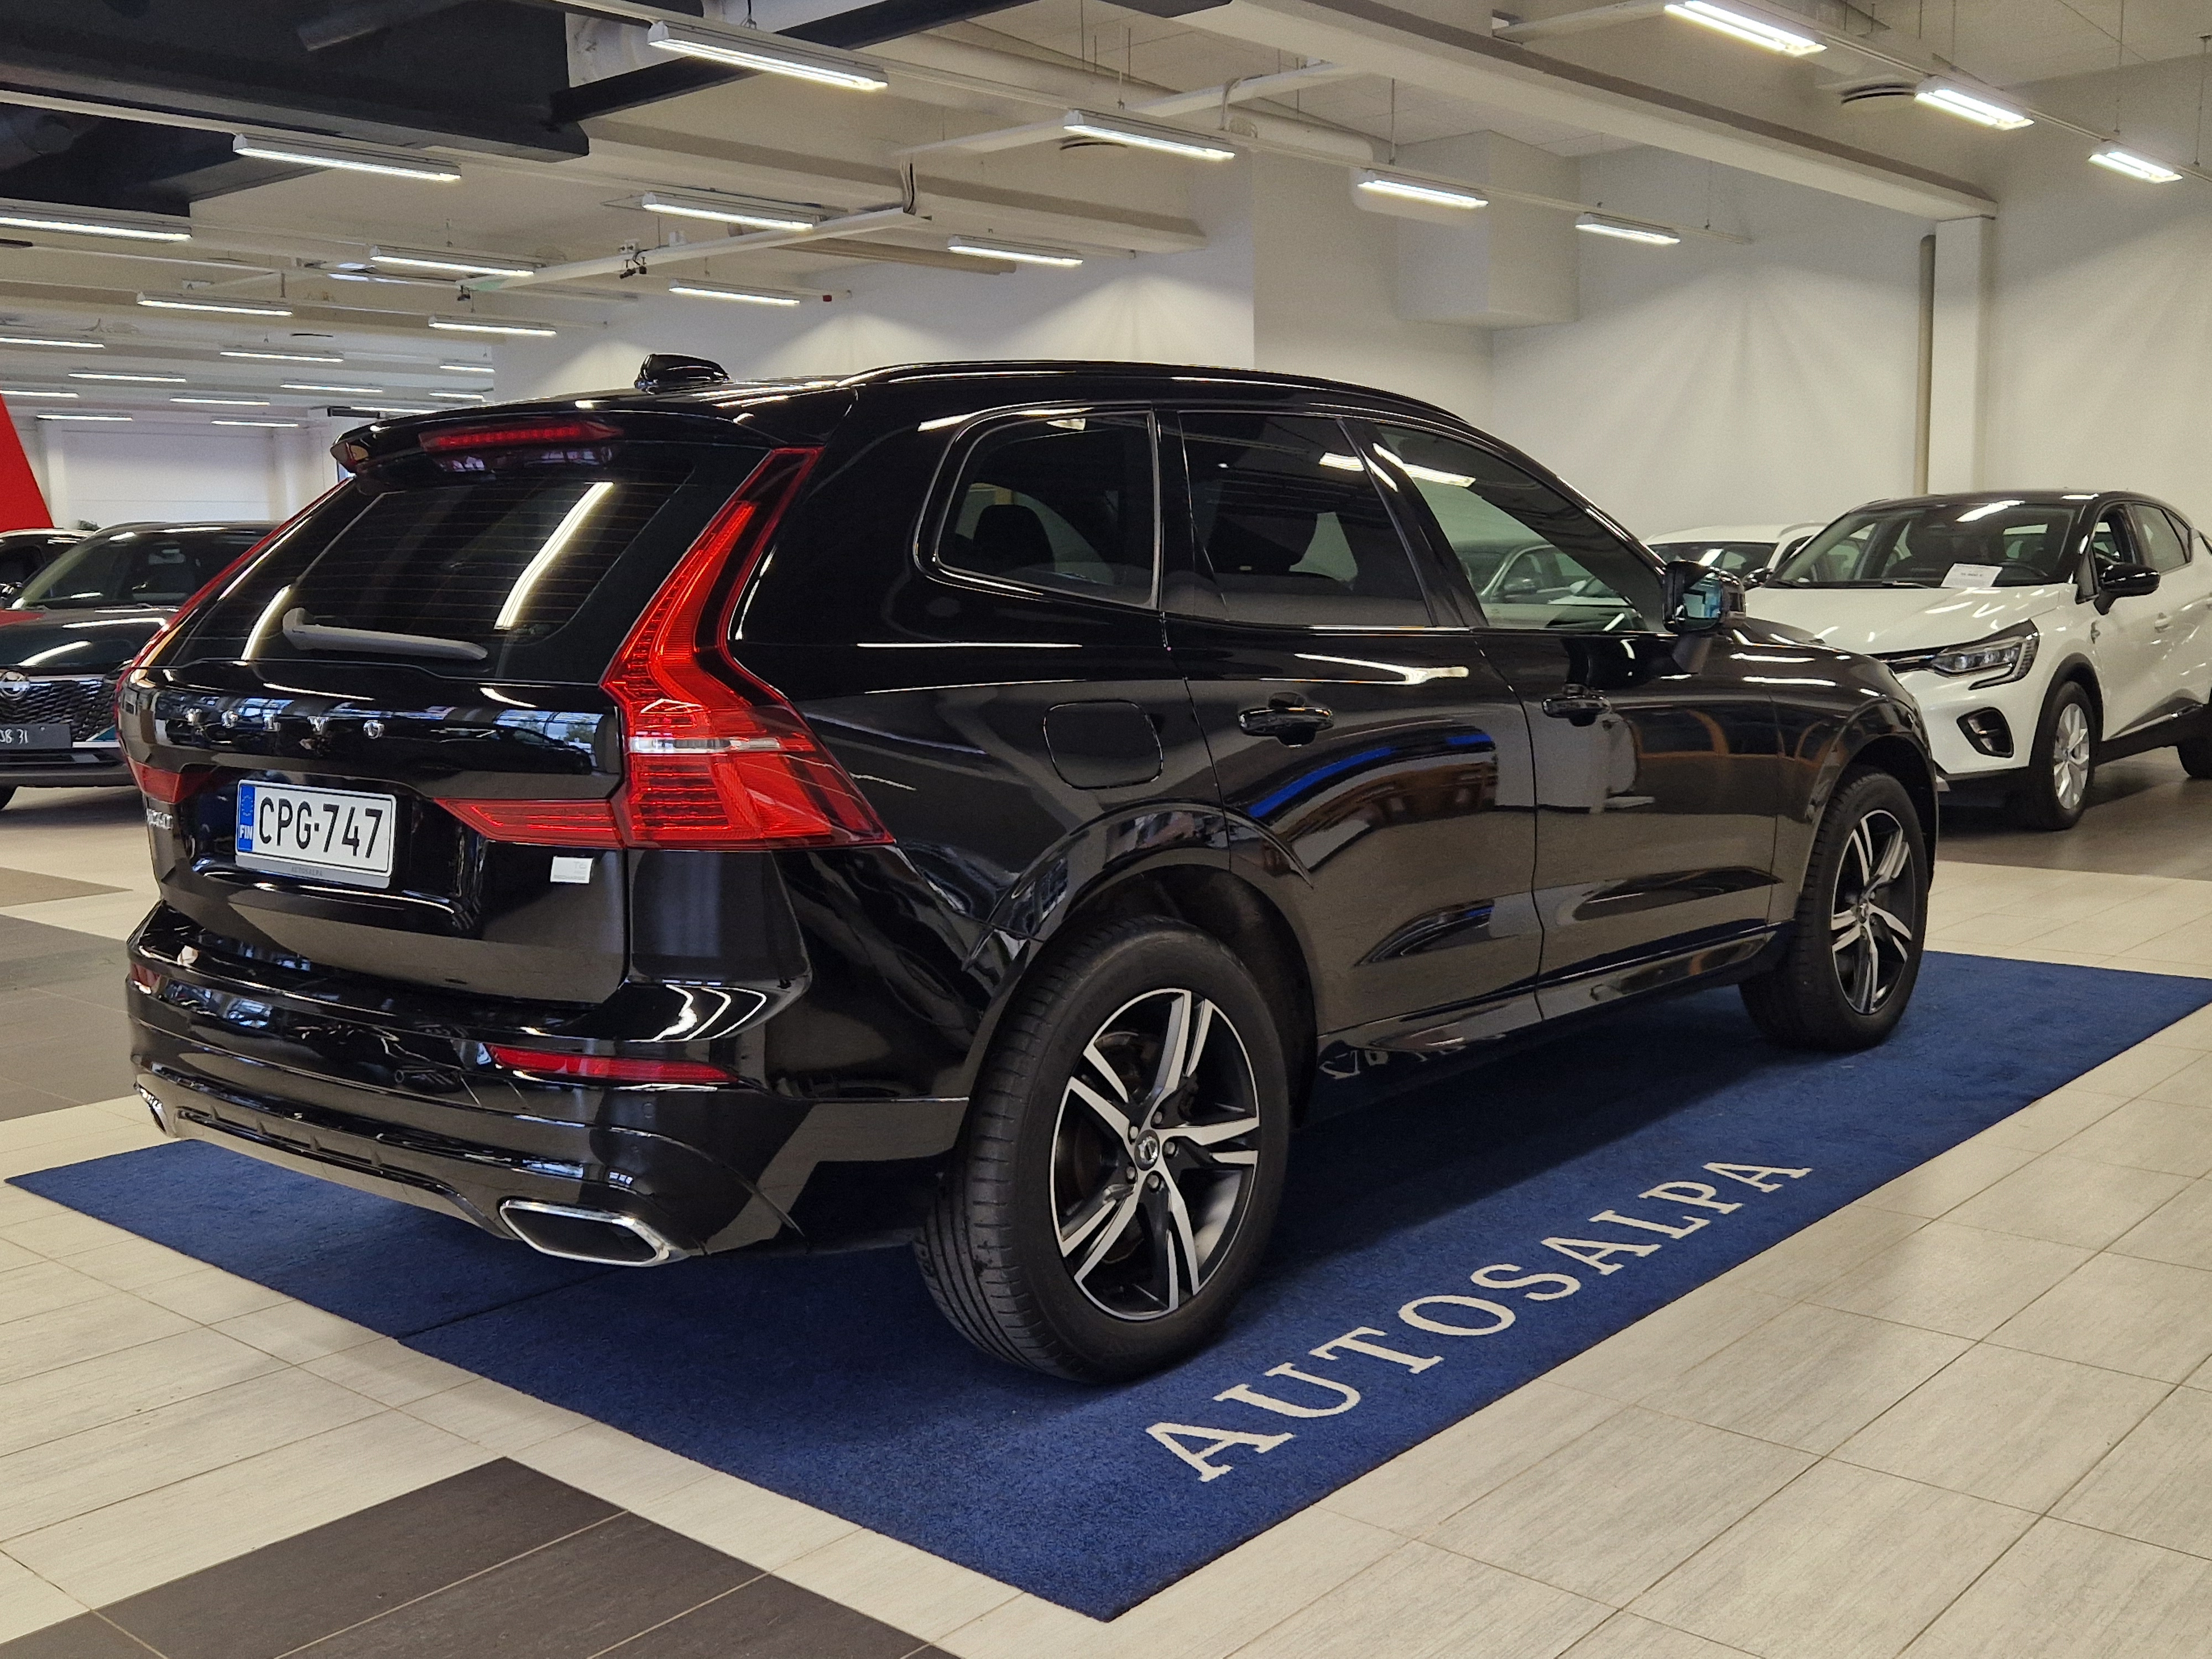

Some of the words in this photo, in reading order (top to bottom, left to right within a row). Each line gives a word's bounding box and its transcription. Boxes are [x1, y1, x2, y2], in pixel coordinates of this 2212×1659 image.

[185, 707, 385, 740] VOLVO
[239, 824, 253, 840] FIN
[259, 796, 383, 859] CPG-747
[1146, 1160, 1813, 1483] AUTOSALPA
